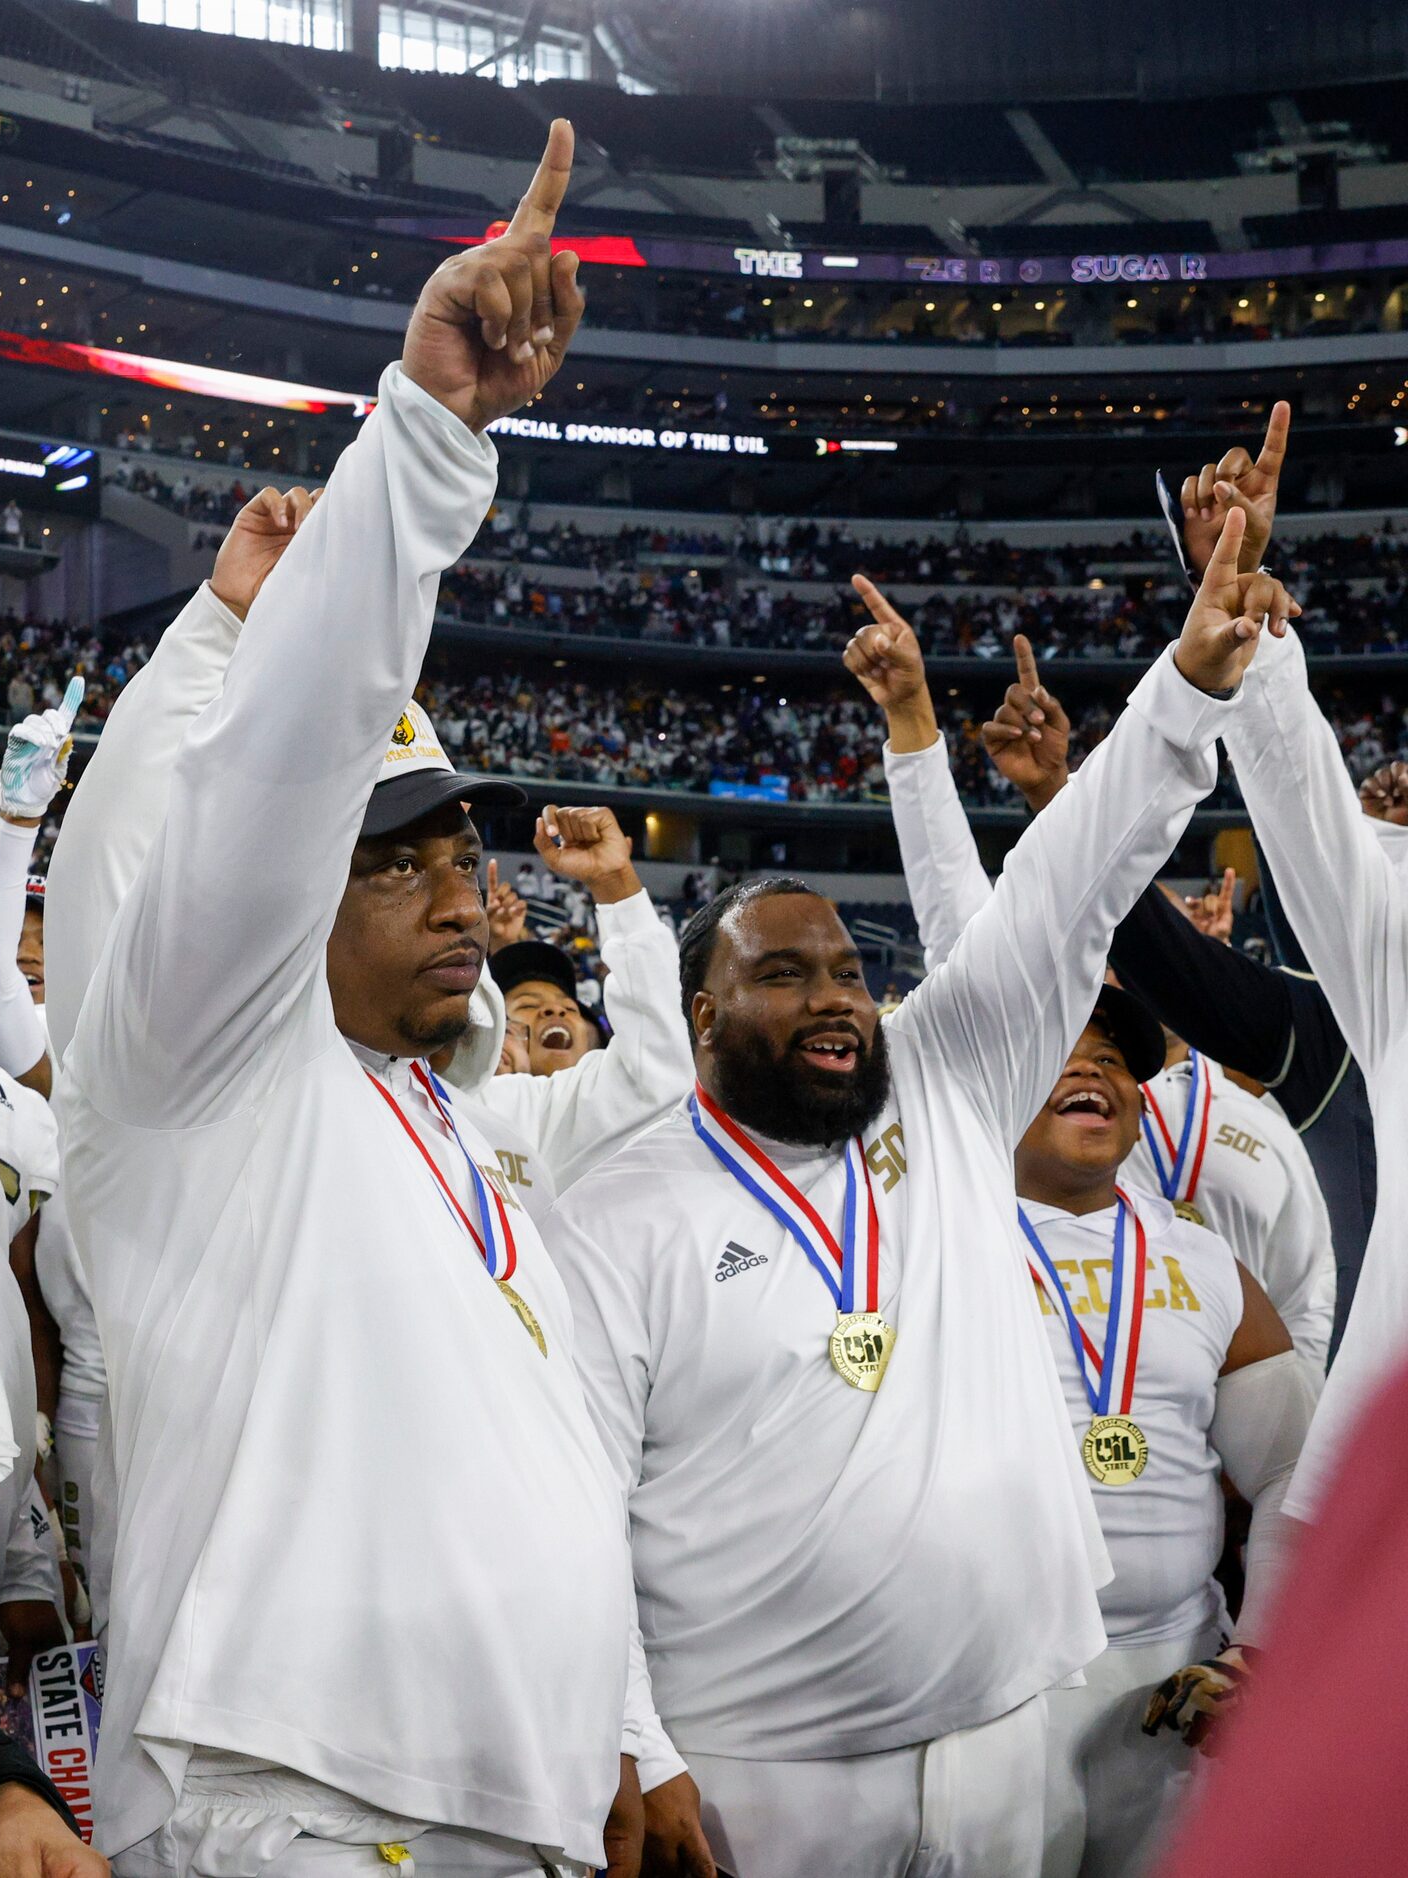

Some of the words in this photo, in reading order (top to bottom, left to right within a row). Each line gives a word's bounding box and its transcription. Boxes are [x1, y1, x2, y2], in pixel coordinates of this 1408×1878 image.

[734, 248, 803, 279] THE
[485, 416, 562, 440] FFICIAL
[564, 423, 656, 447] SPONSOR
[658, 430, 688, 449] OF
[689, 432, 731, 452] THE
[733, 436, 769, 454] UIL
[864, 1122, 908, 1195] SO
[1212, 1122, 1267, 1163] SOC
[714, 1251, 769, 1283] adidas
[1095, 1435, 1136, 1463] UIL
[1103, 1462, 1130, 1472] STATE
[36, 1651, 83, 1740] STATE
